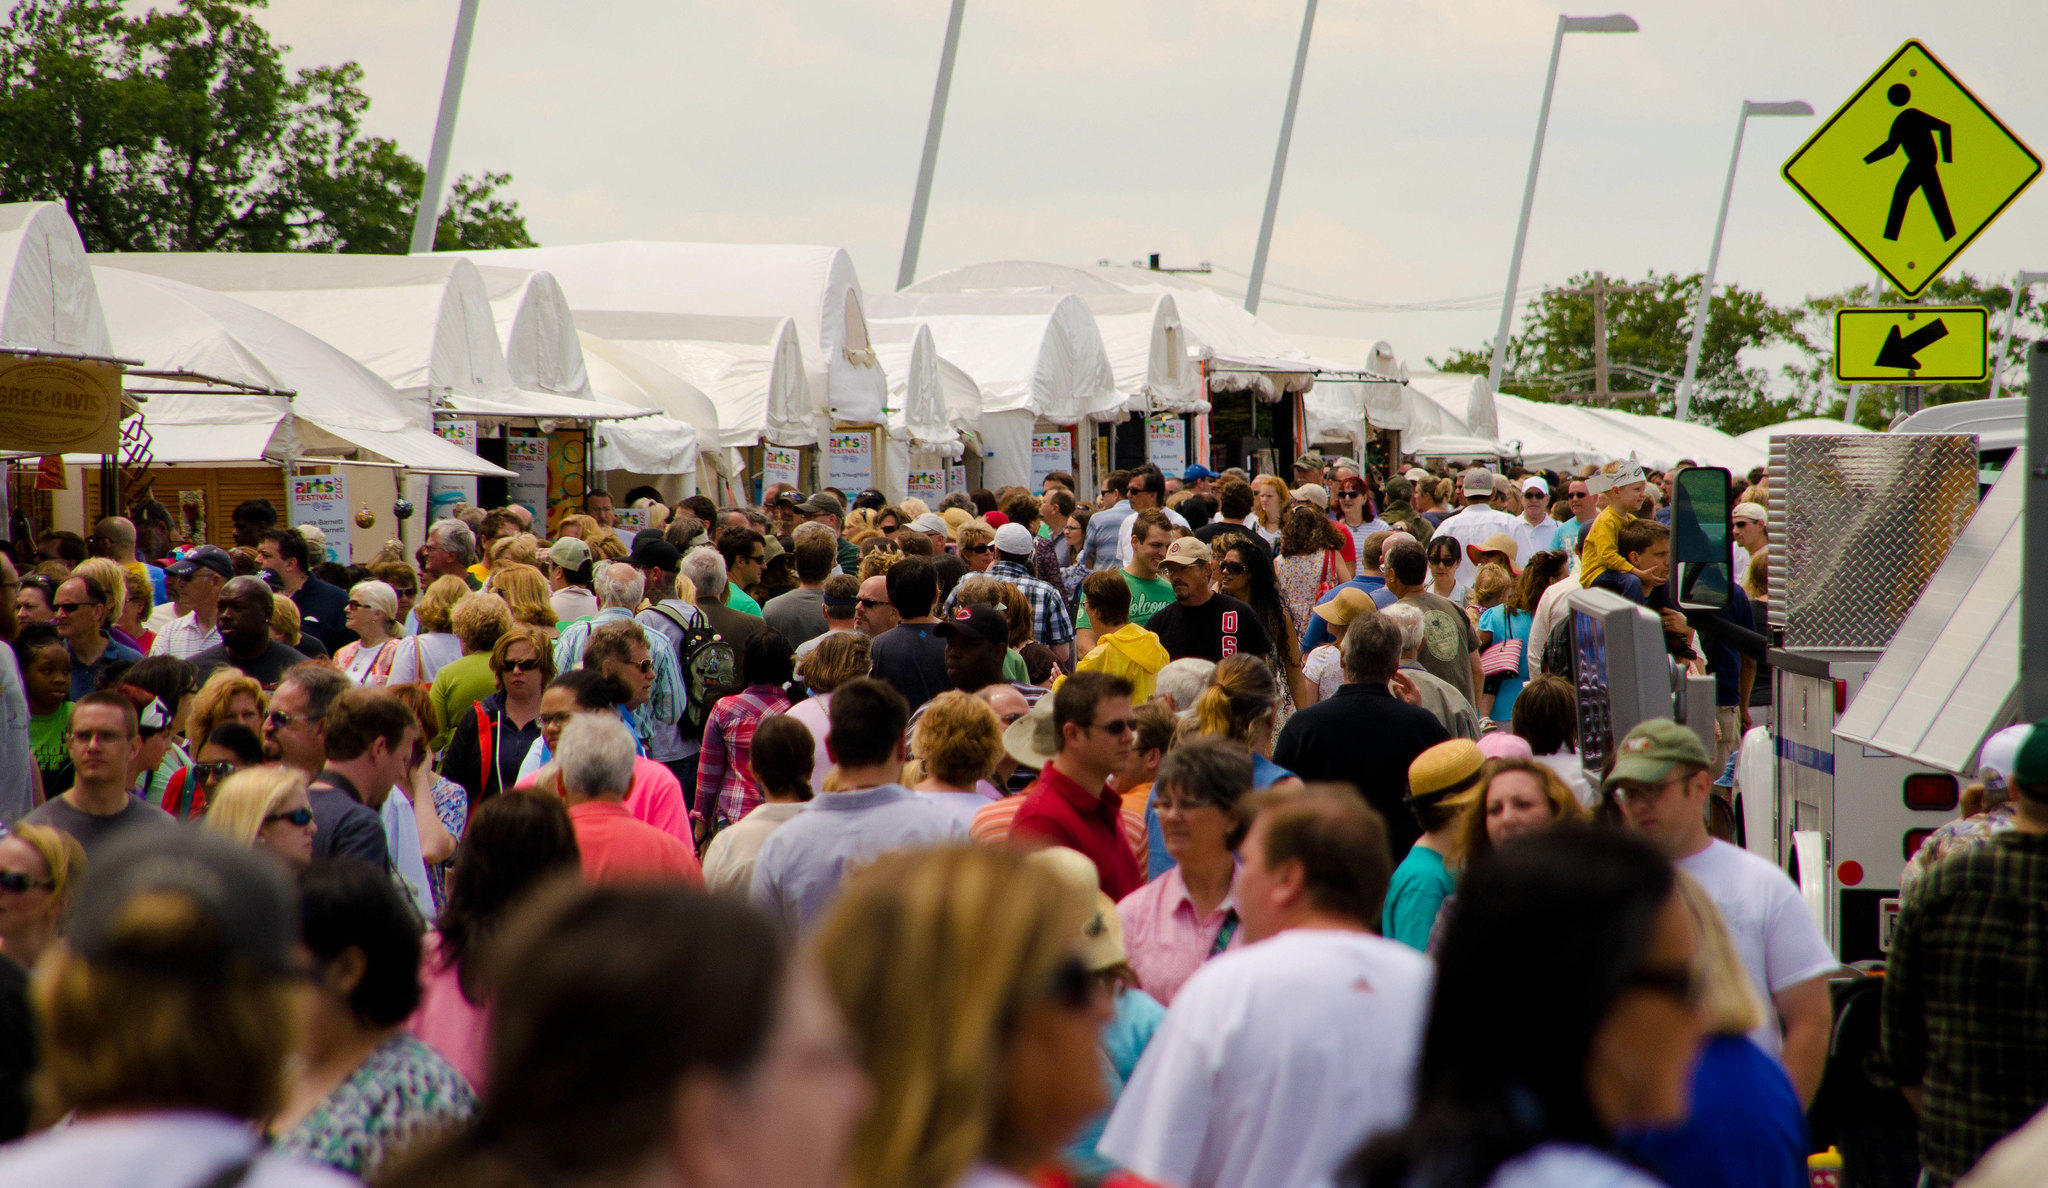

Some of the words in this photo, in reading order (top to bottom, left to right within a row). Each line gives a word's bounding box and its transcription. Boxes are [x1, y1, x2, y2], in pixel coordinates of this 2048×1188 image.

[51, 391, 101, 412] DAVIS
[466, 424, 474, 446] 2012
[830, 436, 860, 449] arts
[1032, 436, 1061, 448] arts
[537, 441, 545, 462] 2012
[766, 451, 791, 465] arts
[295, 478, 334, 494] arts
[909, 472, 936, 484] arts
[935, 471, 943, 490] 2012
[335, 477, 344, 500] 2012
